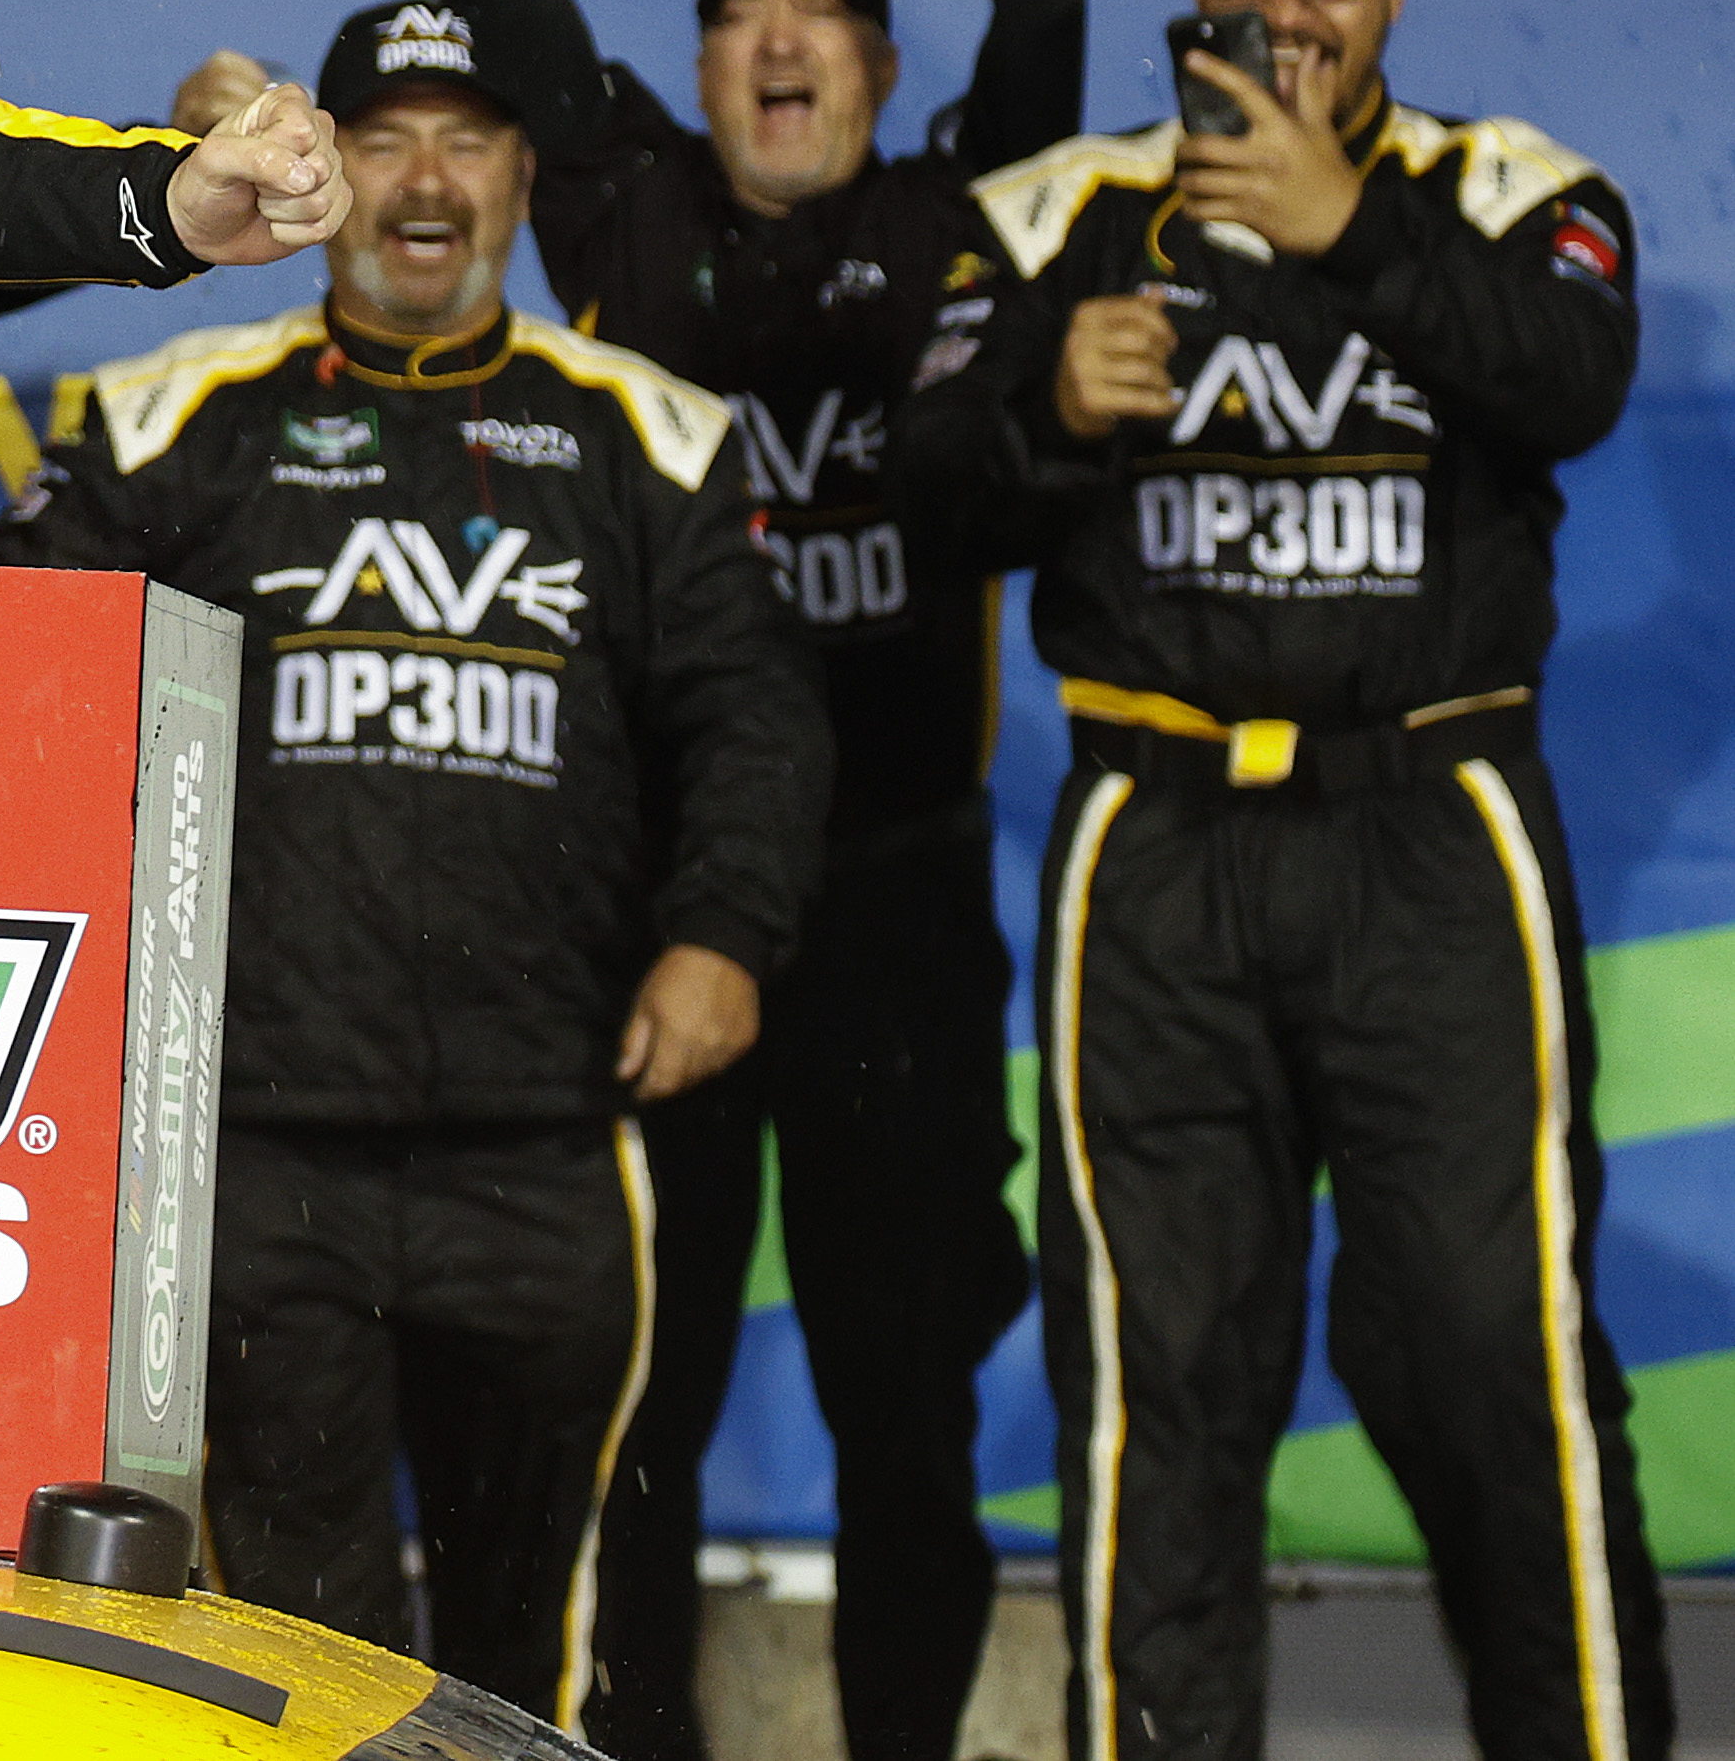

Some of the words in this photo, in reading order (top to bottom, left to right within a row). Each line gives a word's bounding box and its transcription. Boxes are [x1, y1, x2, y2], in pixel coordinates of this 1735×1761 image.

[1138, 473, 1427, 578] OP300
[271, 650, 561, 769] OP300
[167, 753, 189, 936] AUTO
[179, 739, 205, 960] PARTS
[131, 905, 158, 1155] NASCAR
[193, 984, 215, 1188] SERIES
[143, 966, 193, 1408] O'Reilly
